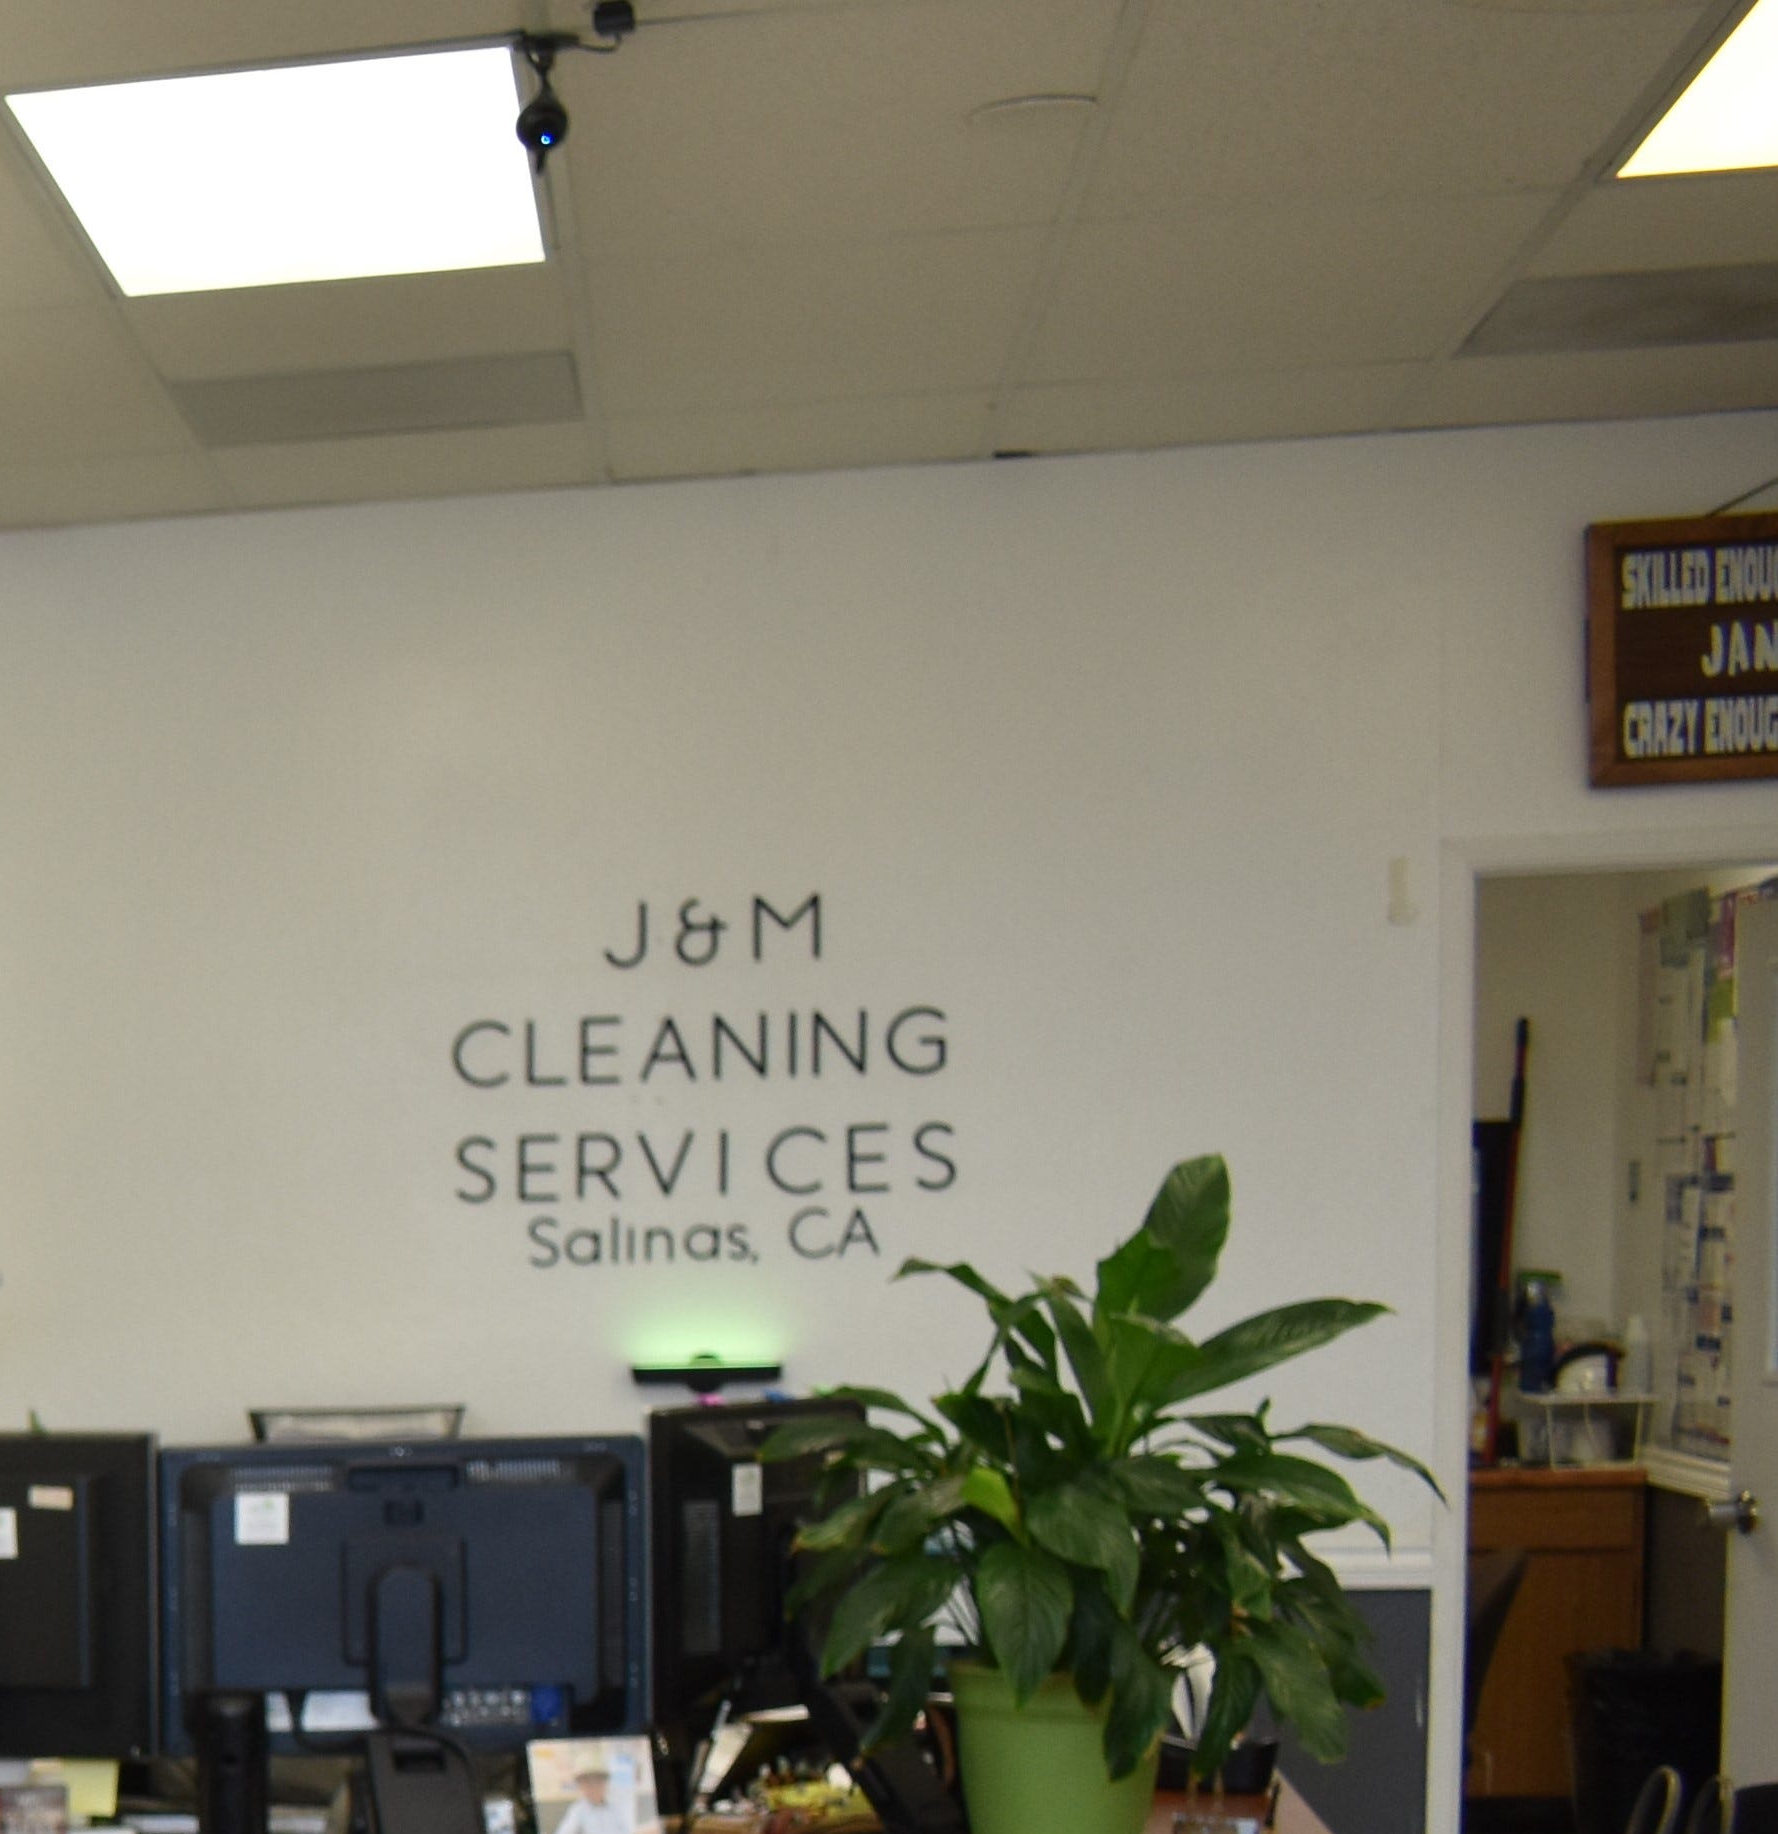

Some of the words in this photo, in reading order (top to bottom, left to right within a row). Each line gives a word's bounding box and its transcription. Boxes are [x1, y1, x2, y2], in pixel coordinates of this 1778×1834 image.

[1621, 549, 1711, 609] SKILLED
[1715, 544, 1778, 605] ENOU
[1623, 699, 1699, 759] CRAZY
[451, 1005, 949, 1088] CLEANING
[455, 1121, 958, 1203] SERVICES
[527, 1215, 760, 1267] Salinas,
[787, 1206, 881, 1260] CA
